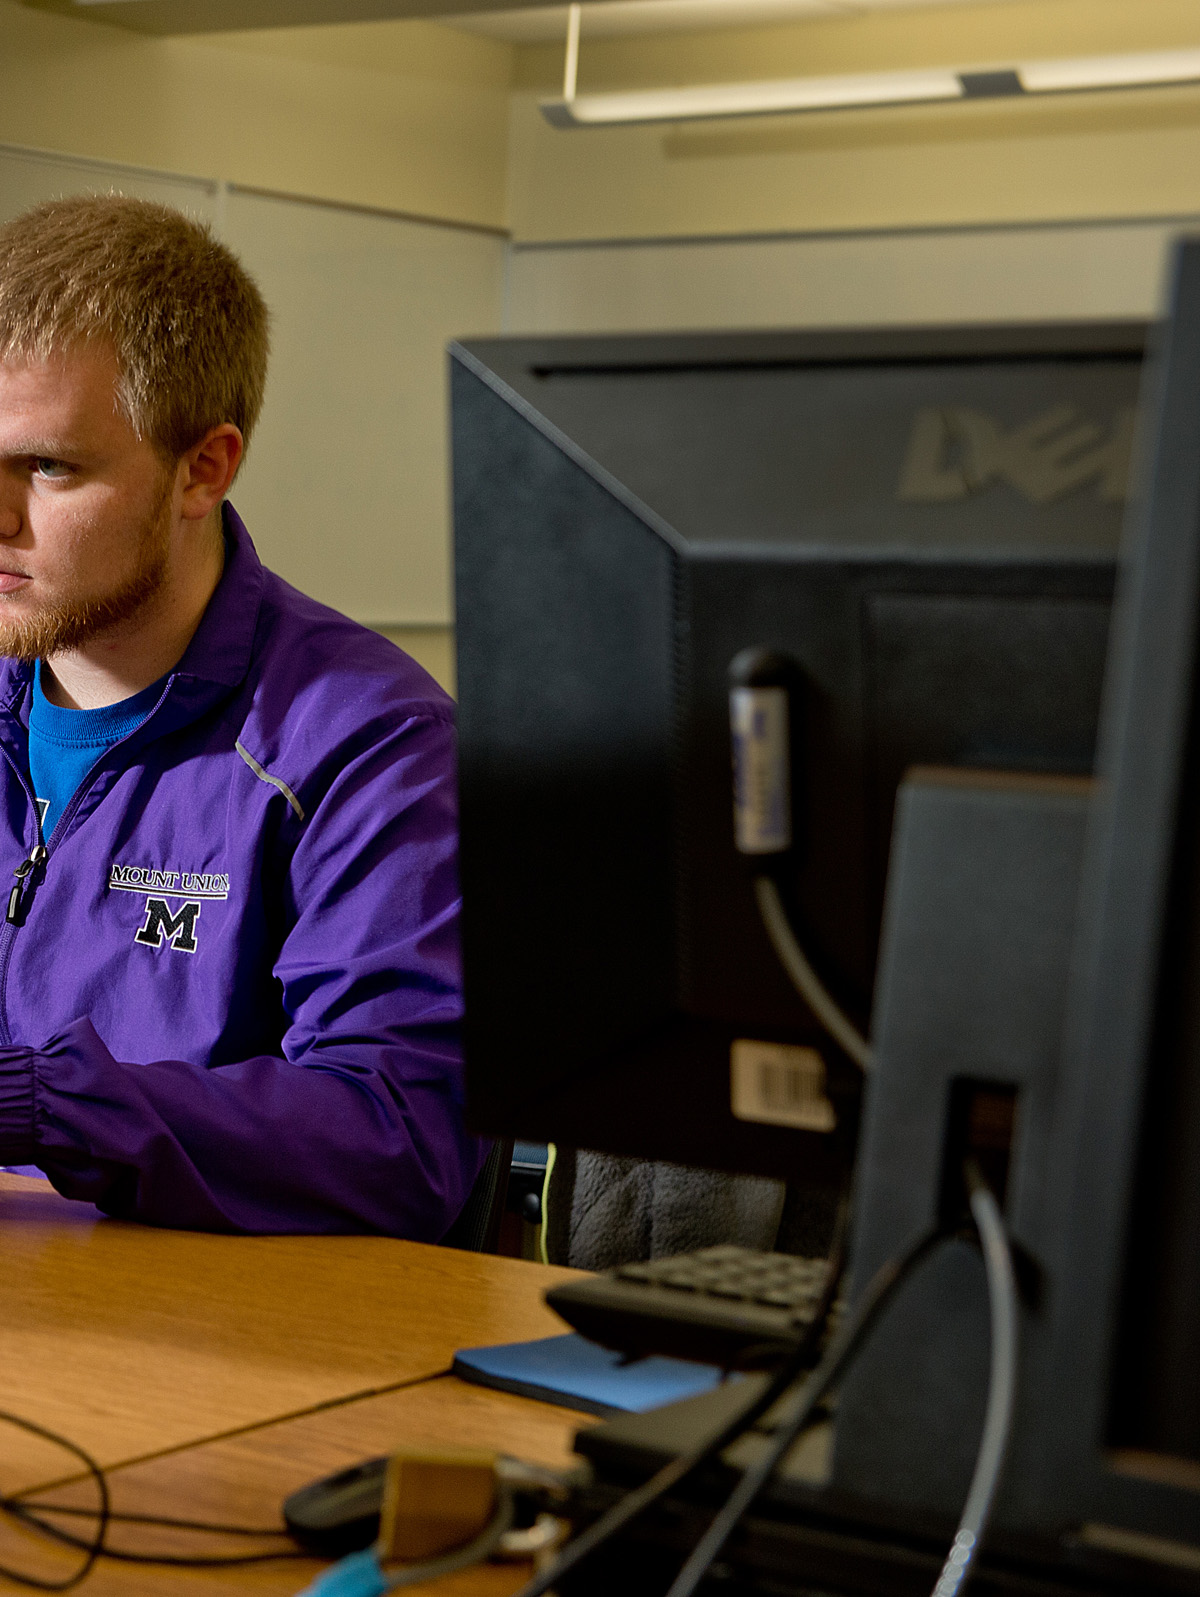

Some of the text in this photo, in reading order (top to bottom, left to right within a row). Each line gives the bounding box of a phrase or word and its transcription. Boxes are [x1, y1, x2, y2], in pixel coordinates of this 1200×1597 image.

[110, 864, 230, 891] MOUNT UNION
[134, 896, 200, 954] M
